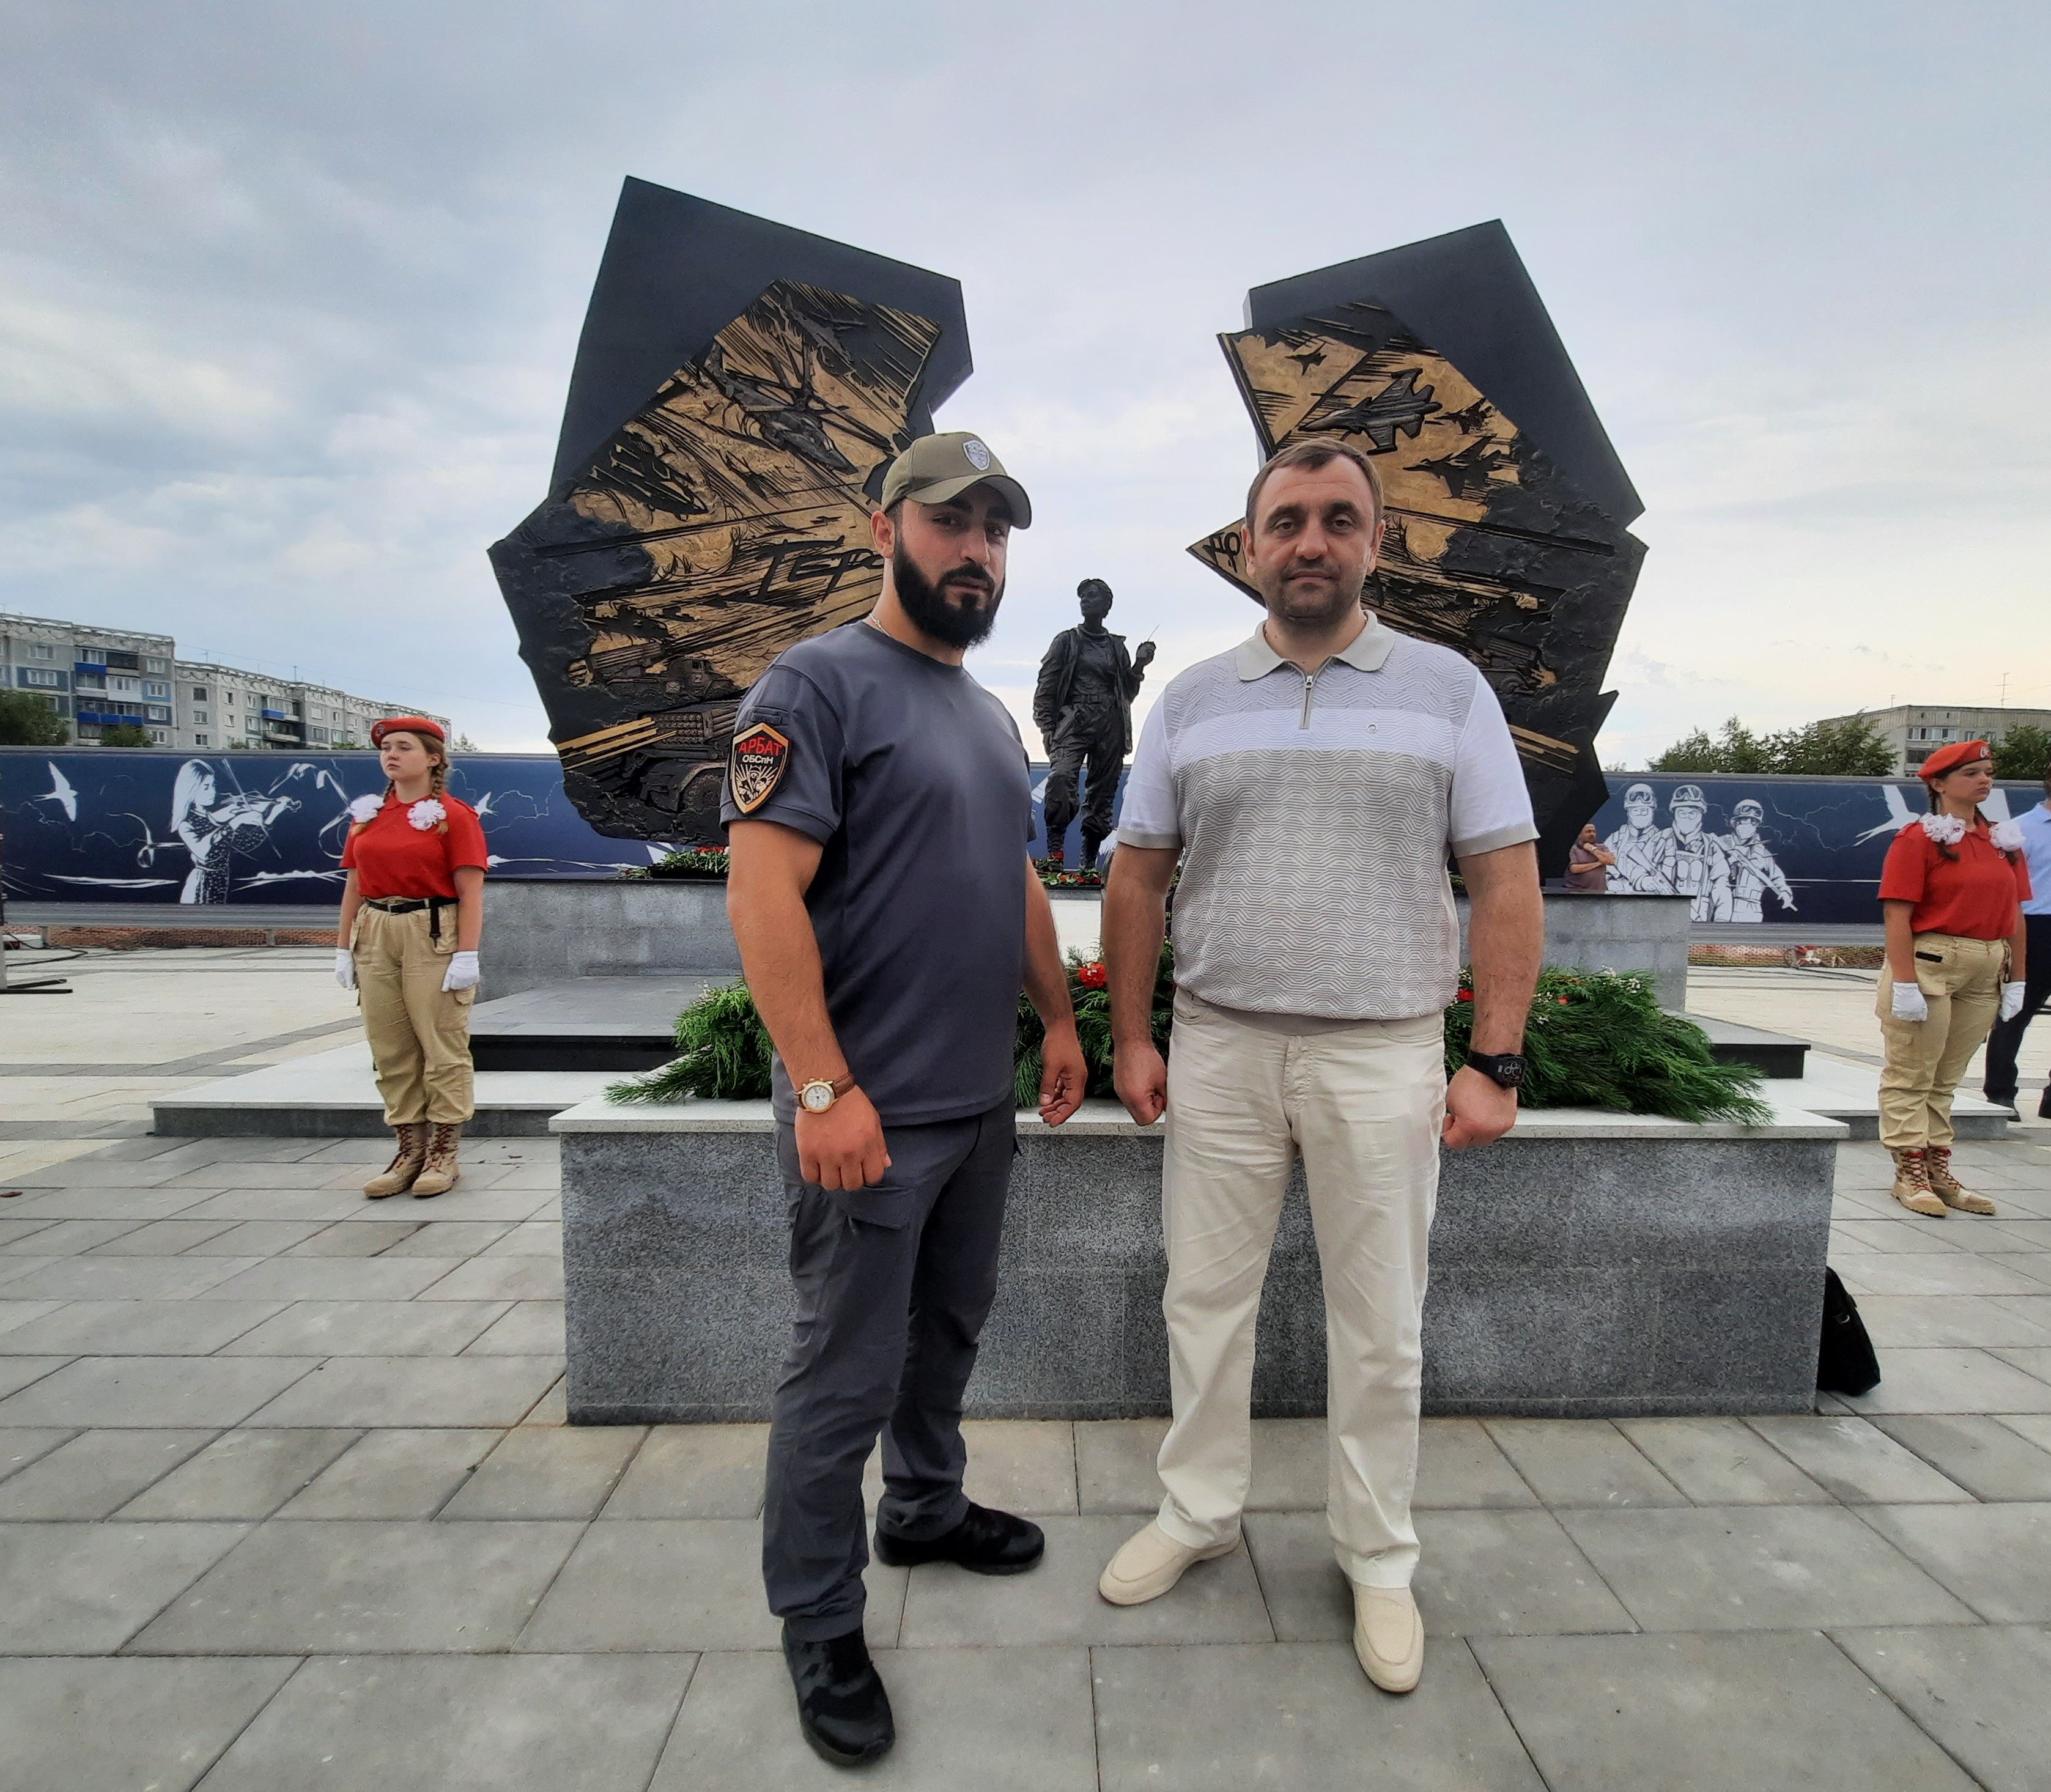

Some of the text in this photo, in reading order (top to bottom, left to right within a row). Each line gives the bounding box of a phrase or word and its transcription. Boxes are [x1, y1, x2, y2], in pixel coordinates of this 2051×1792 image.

[694, 674, 703, 684] Z
[738, 736, 783, 756] АРБАТ
[742, 754, 774, 764] ОБСпН
